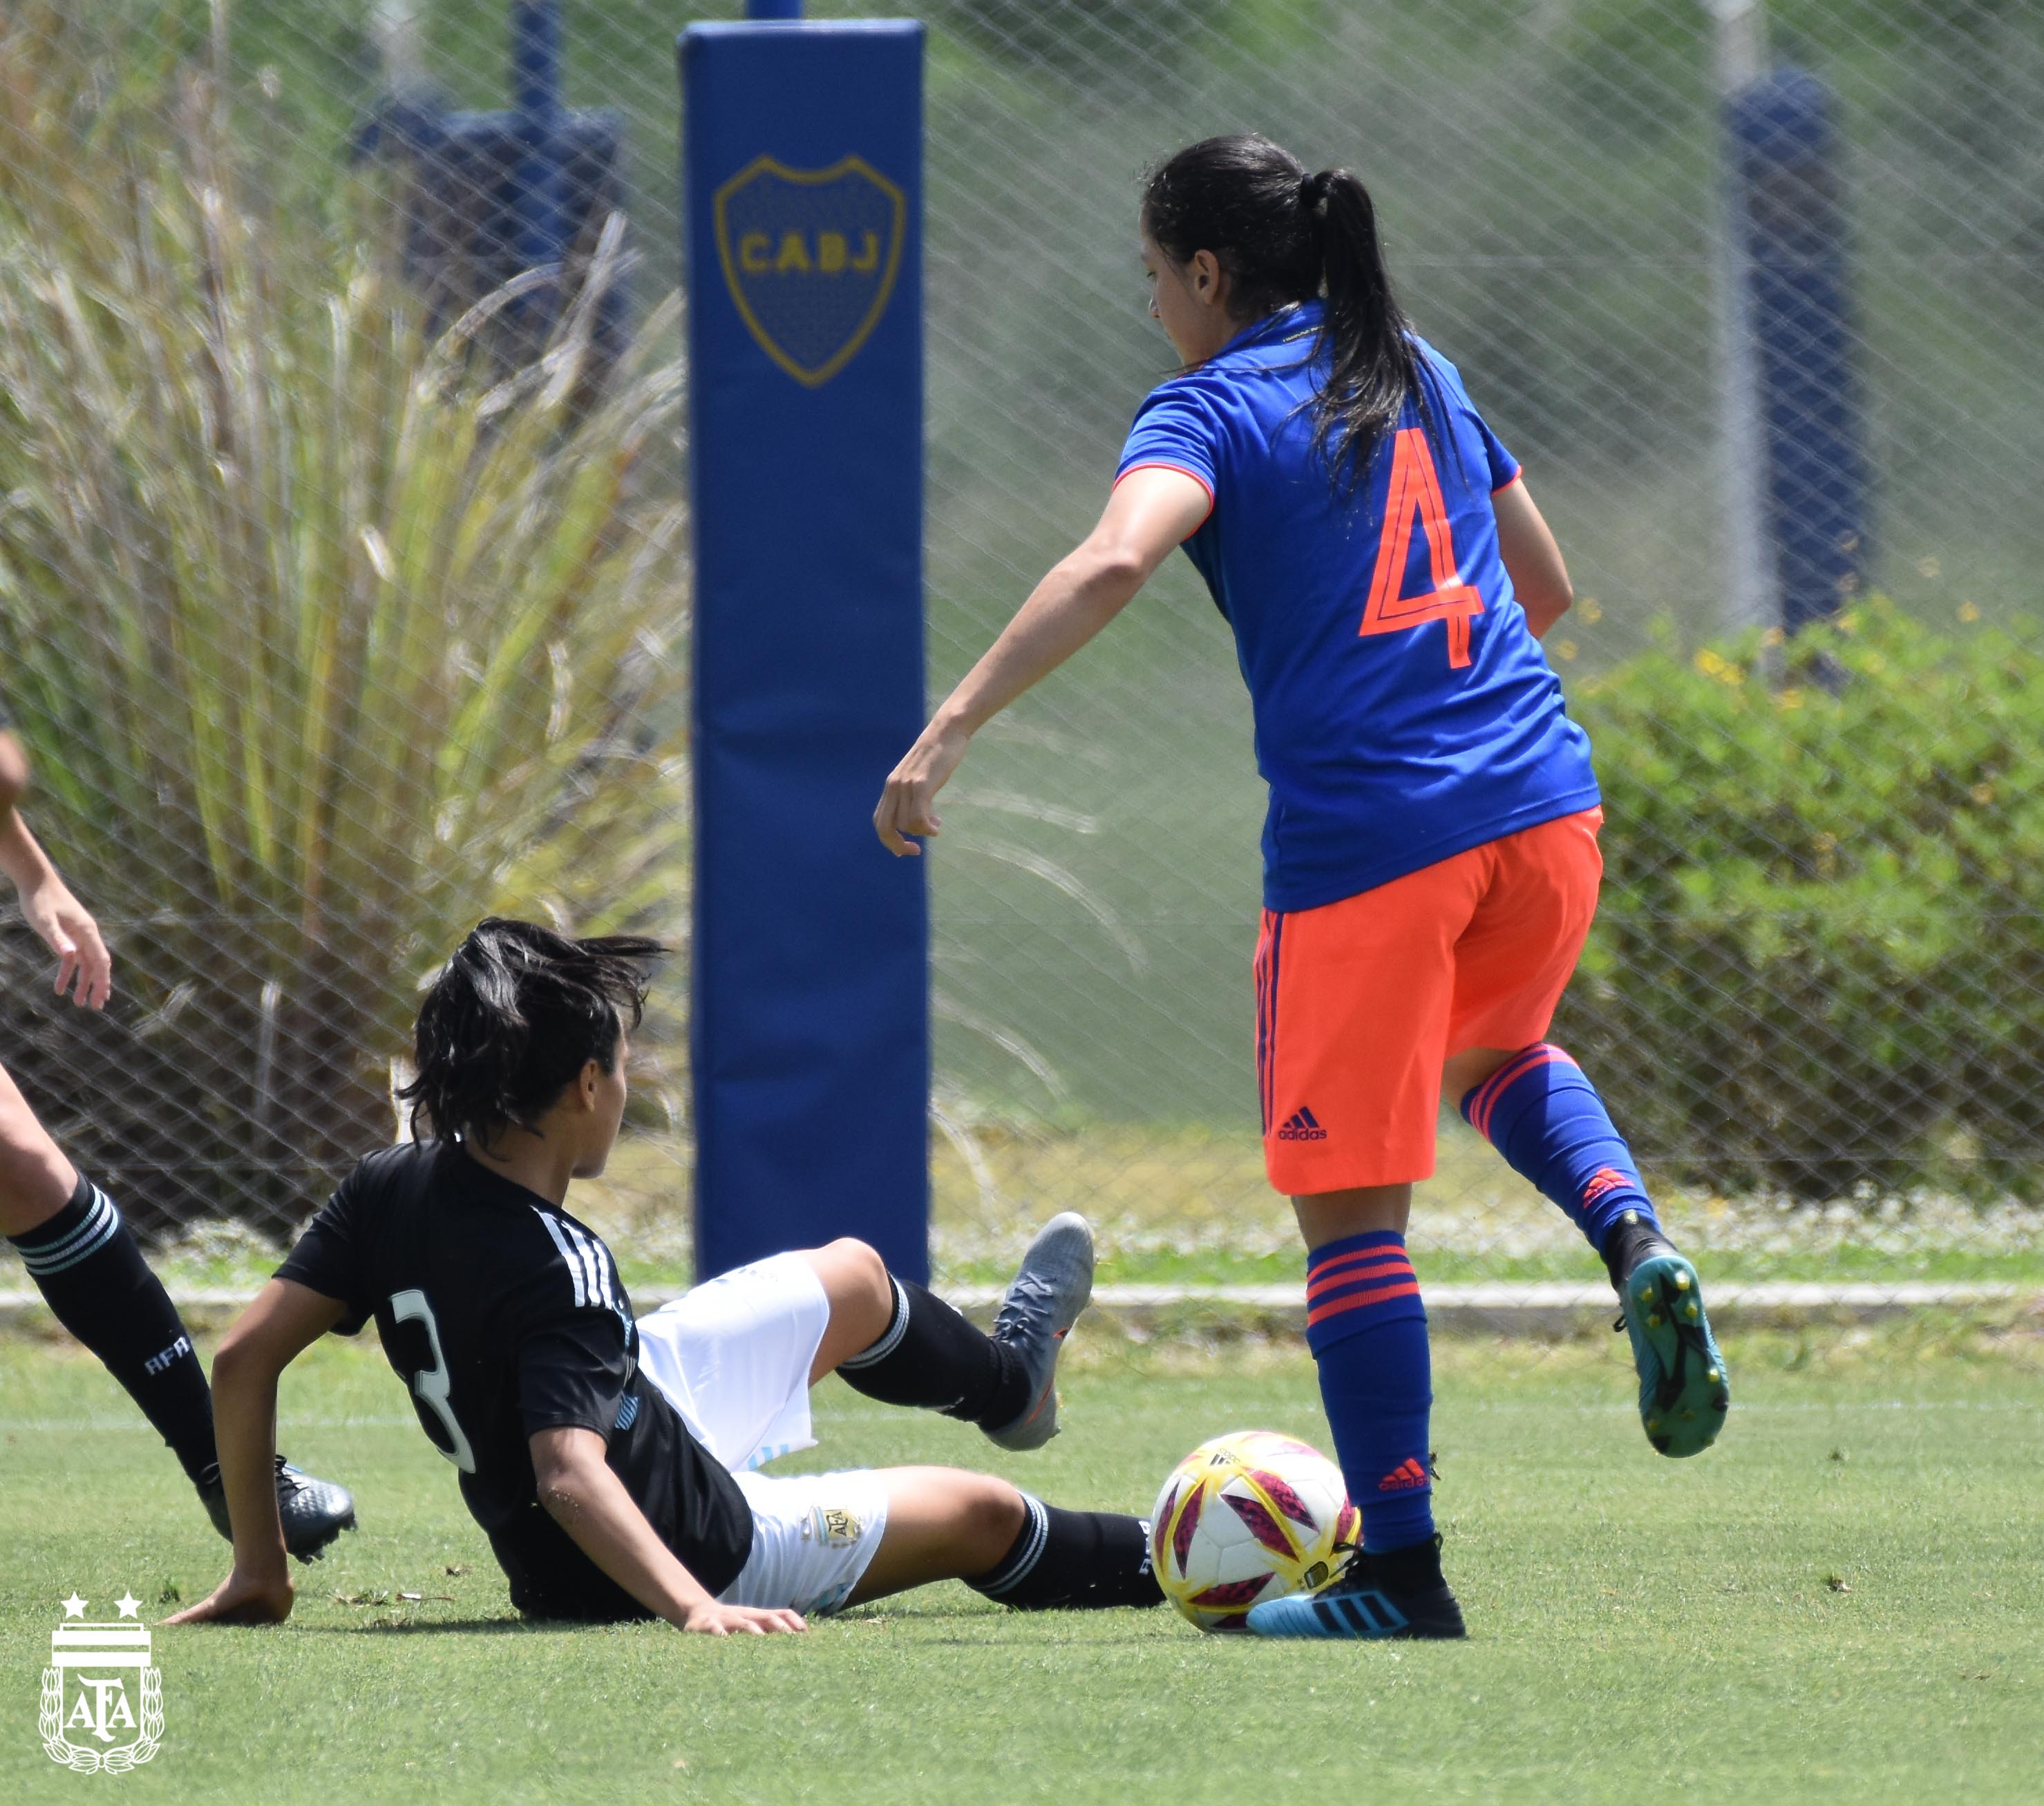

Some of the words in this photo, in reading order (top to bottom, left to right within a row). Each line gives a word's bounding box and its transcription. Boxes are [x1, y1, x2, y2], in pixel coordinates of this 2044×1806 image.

[1359, 428, 1485, 669] 4
[1278, 1128, 1327, 1141] adidas
[144, 1336, 190, 1376] AFA
[388, 1289, 476, 1474] 3
